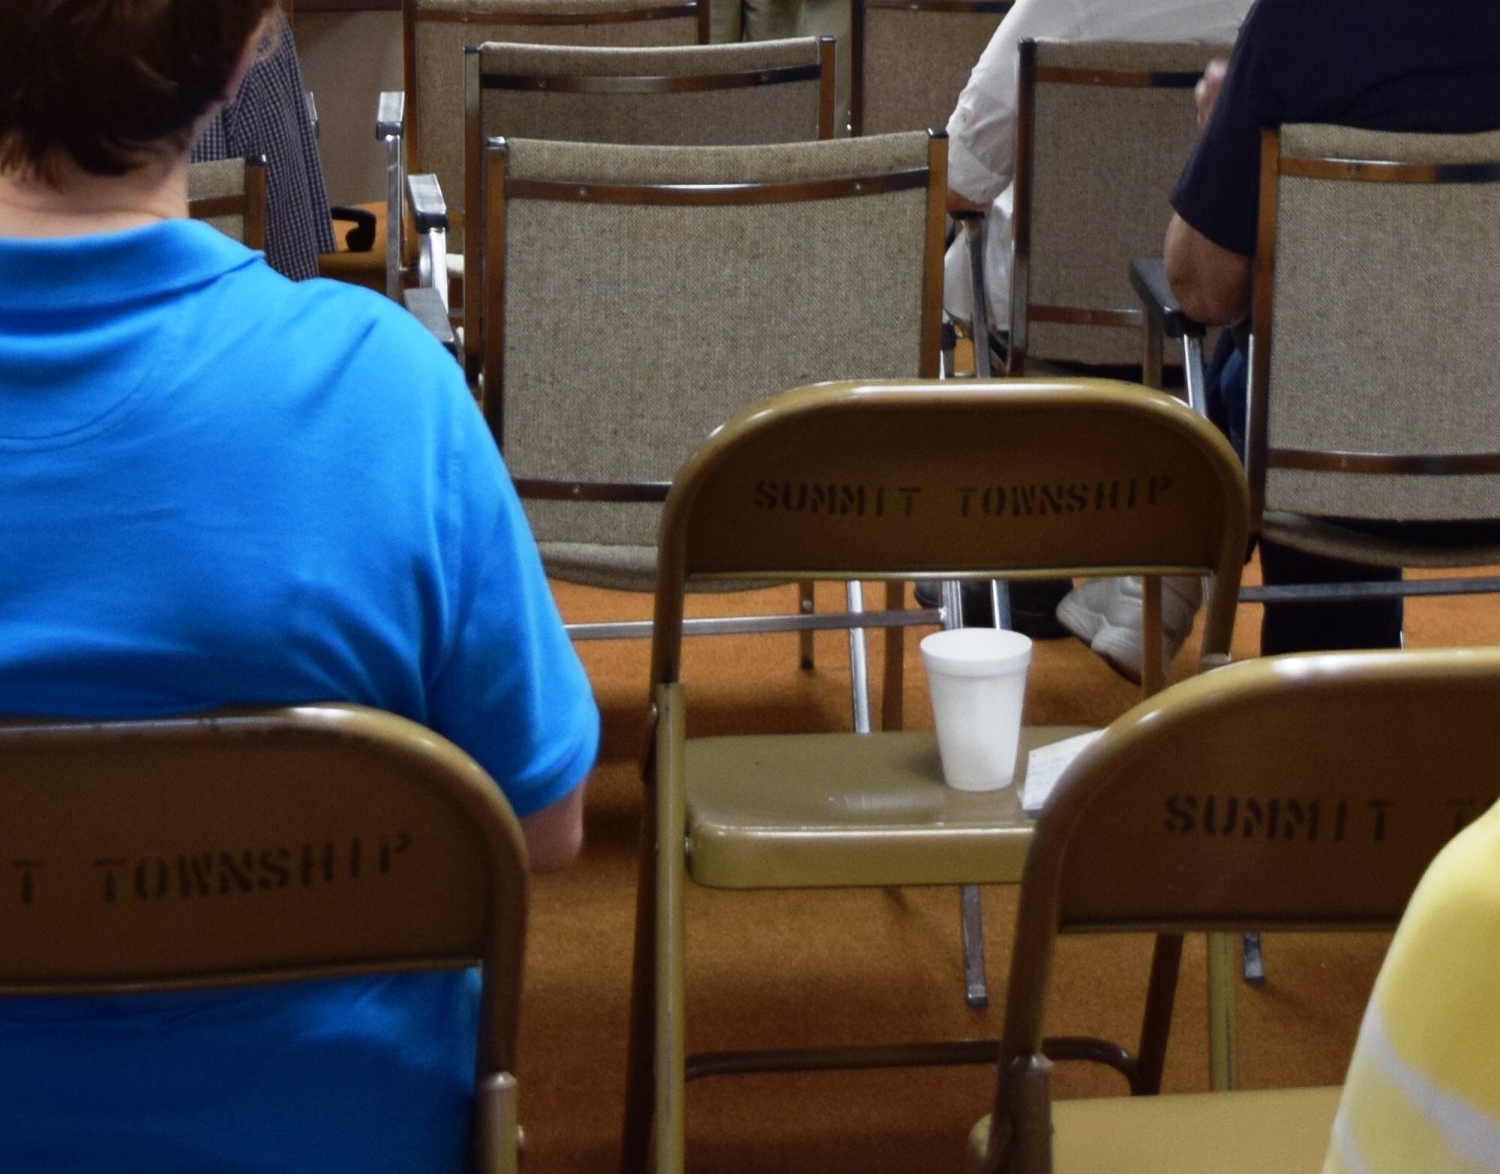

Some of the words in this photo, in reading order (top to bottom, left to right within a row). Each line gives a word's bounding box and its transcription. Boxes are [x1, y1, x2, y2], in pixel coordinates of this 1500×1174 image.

[754, 479, 921, 518] SUMMIT
[960, 476, 1172, 518] TOWNSHIP
[1163, 794, 1397, 842] SUMMIT
[91, 833, 413, 904] TOWNSHIP
